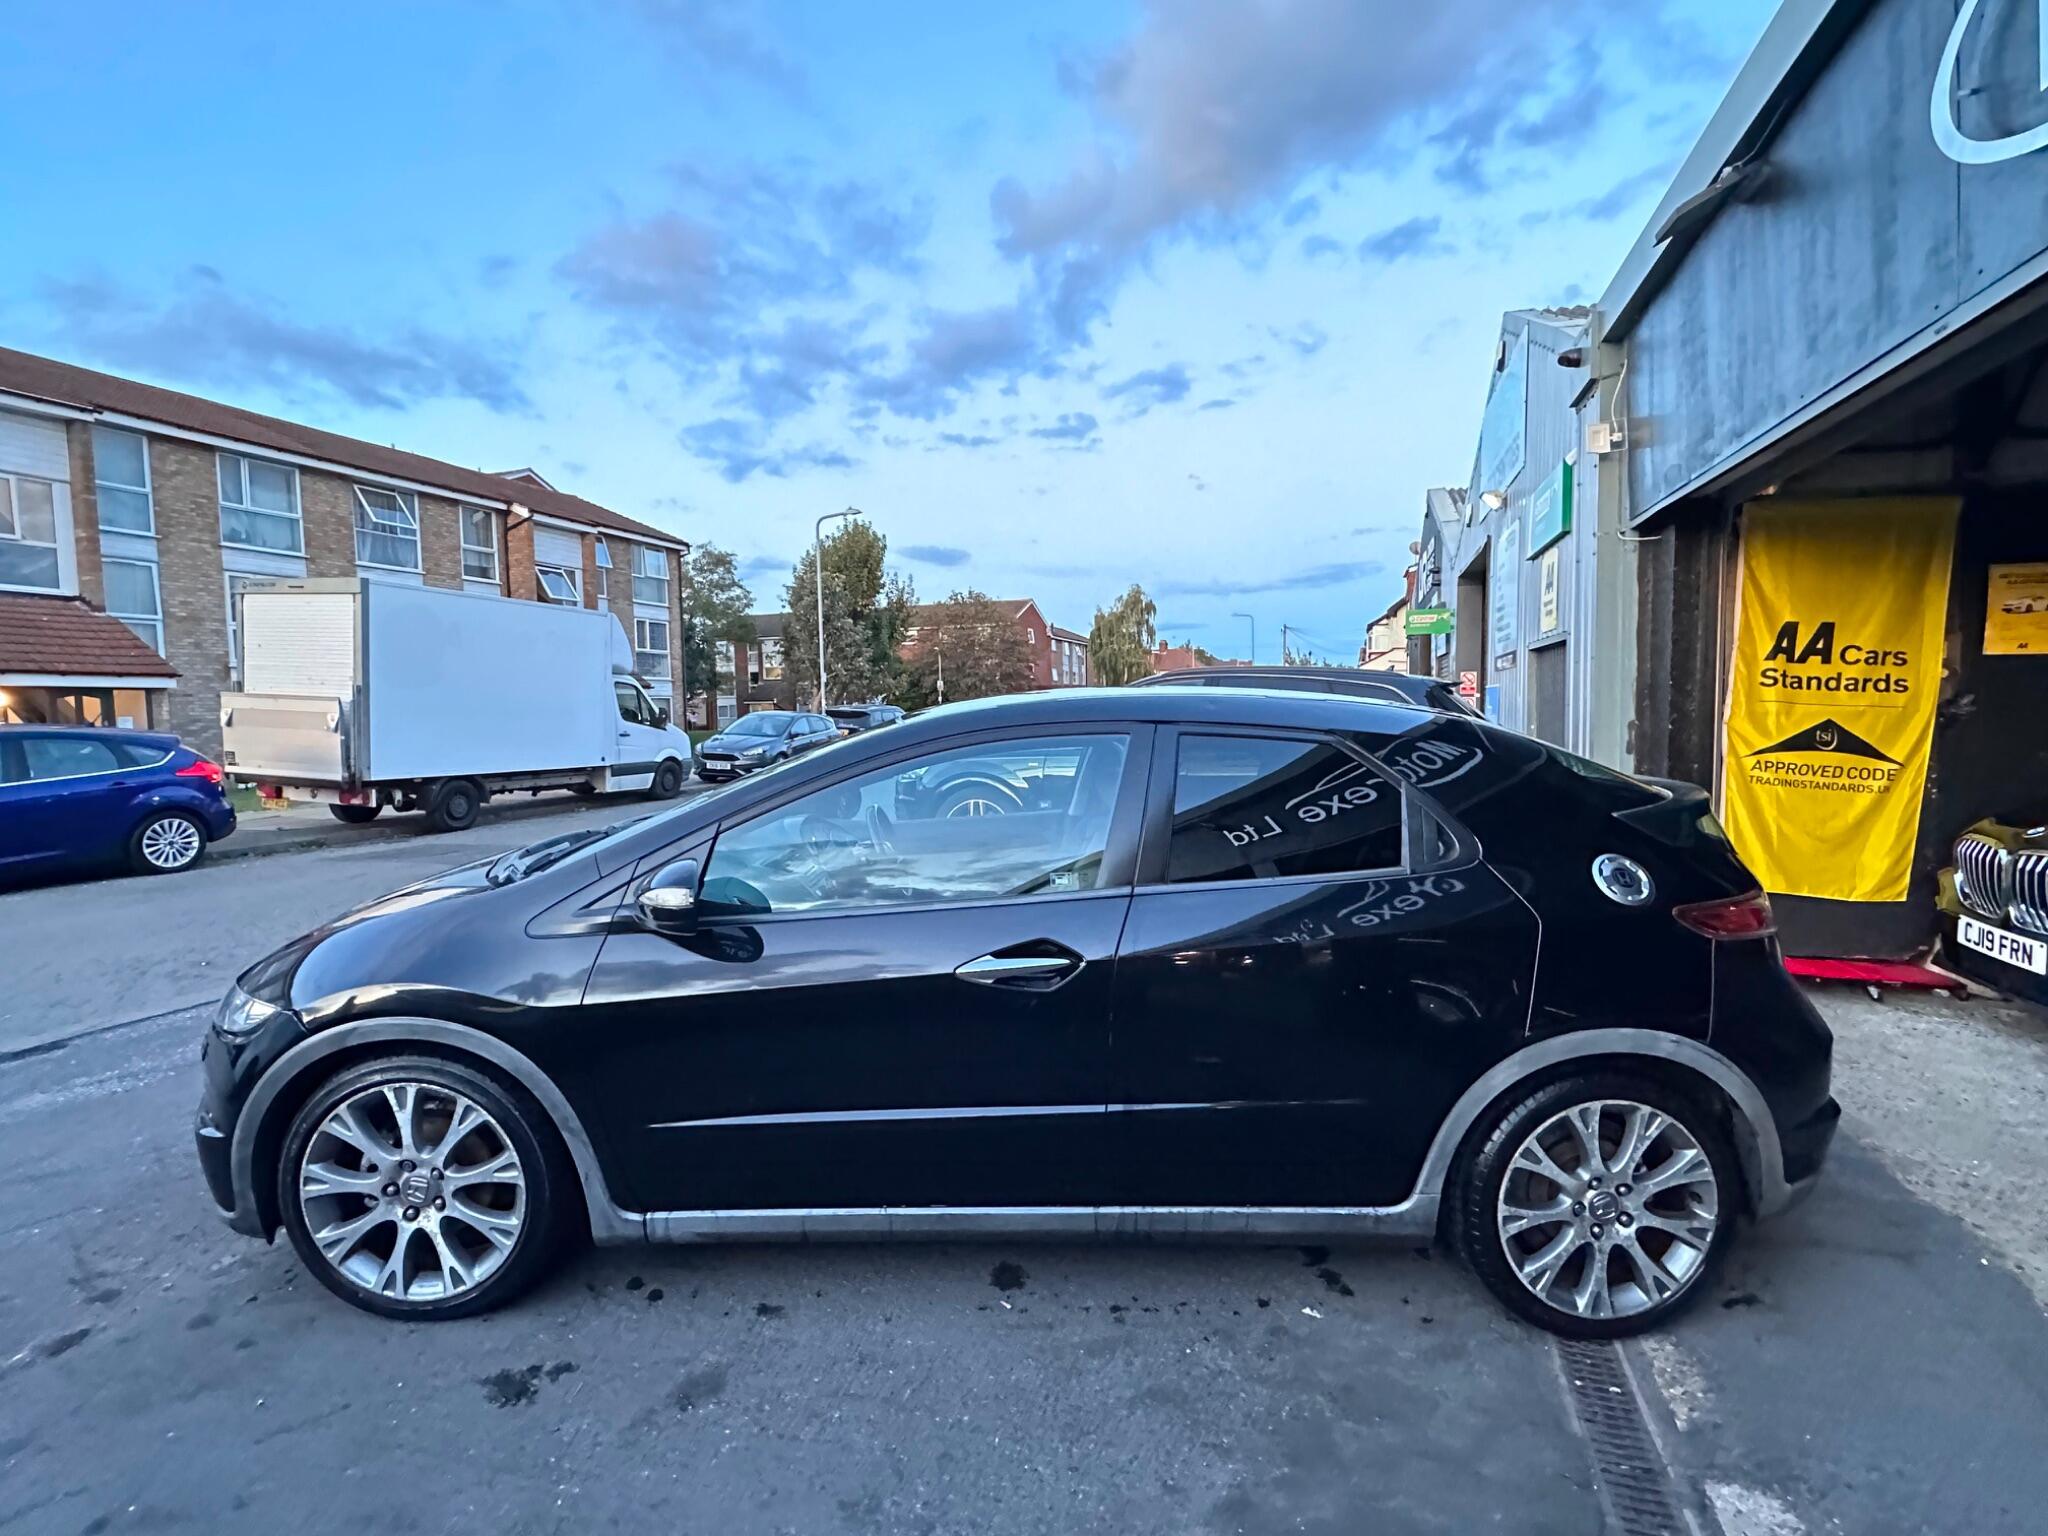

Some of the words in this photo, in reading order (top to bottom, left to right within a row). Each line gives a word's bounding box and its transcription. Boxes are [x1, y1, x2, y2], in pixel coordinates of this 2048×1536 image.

[1764, 621, 1835, 664] AA
[1839, 645, 1908, 666] Cars
[1759, 667, 1909, 693] Standards
[1816, 729, 1832, 742] tsi
[1751, 759, 1844, 779] APPROVED
[1846, 766, 1898, 782] CODE
[1964, 922, 1995, 952] CJ19
[1999, 934, 2033, 966] FRN
